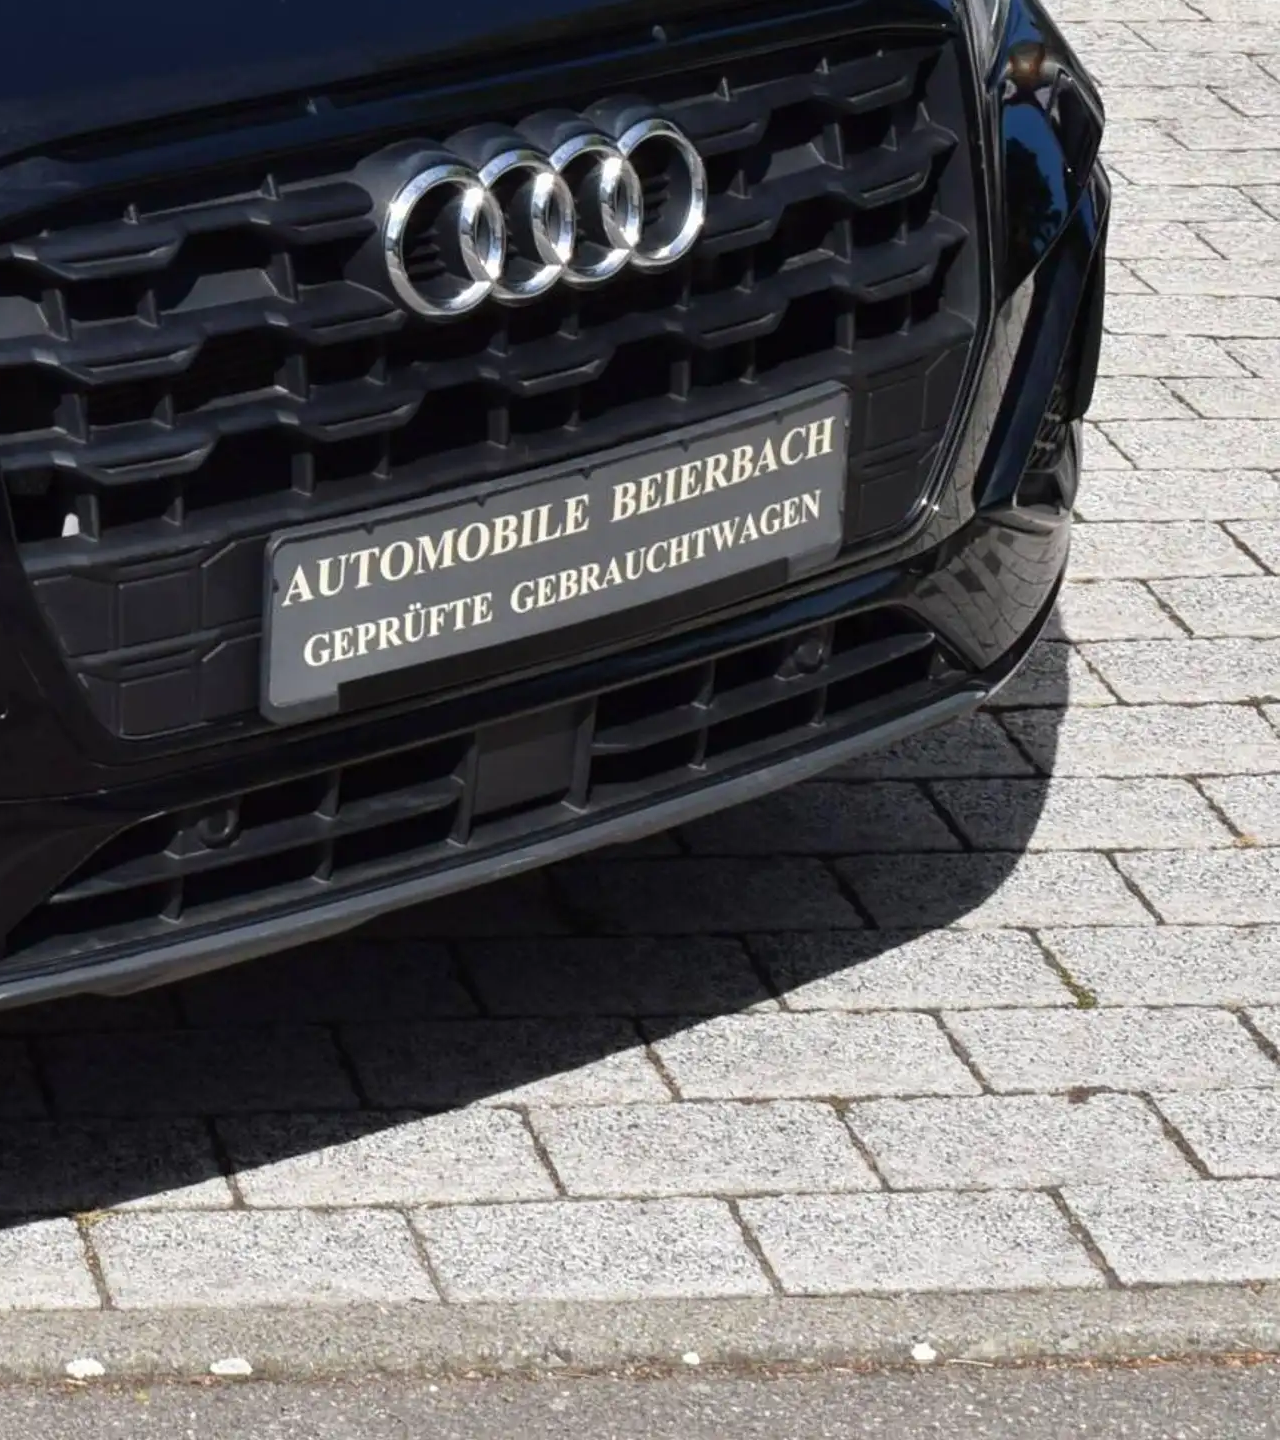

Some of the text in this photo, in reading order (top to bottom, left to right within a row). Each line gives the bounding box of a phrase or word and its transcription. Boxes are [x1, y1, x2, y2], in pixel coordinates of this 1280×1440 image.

[281, 416, 836, 607] AUTOMOBILE BEIERBACH
[302, 489, 821, 667] GEPRÜFTE GEBRAUCHTWAGEN
